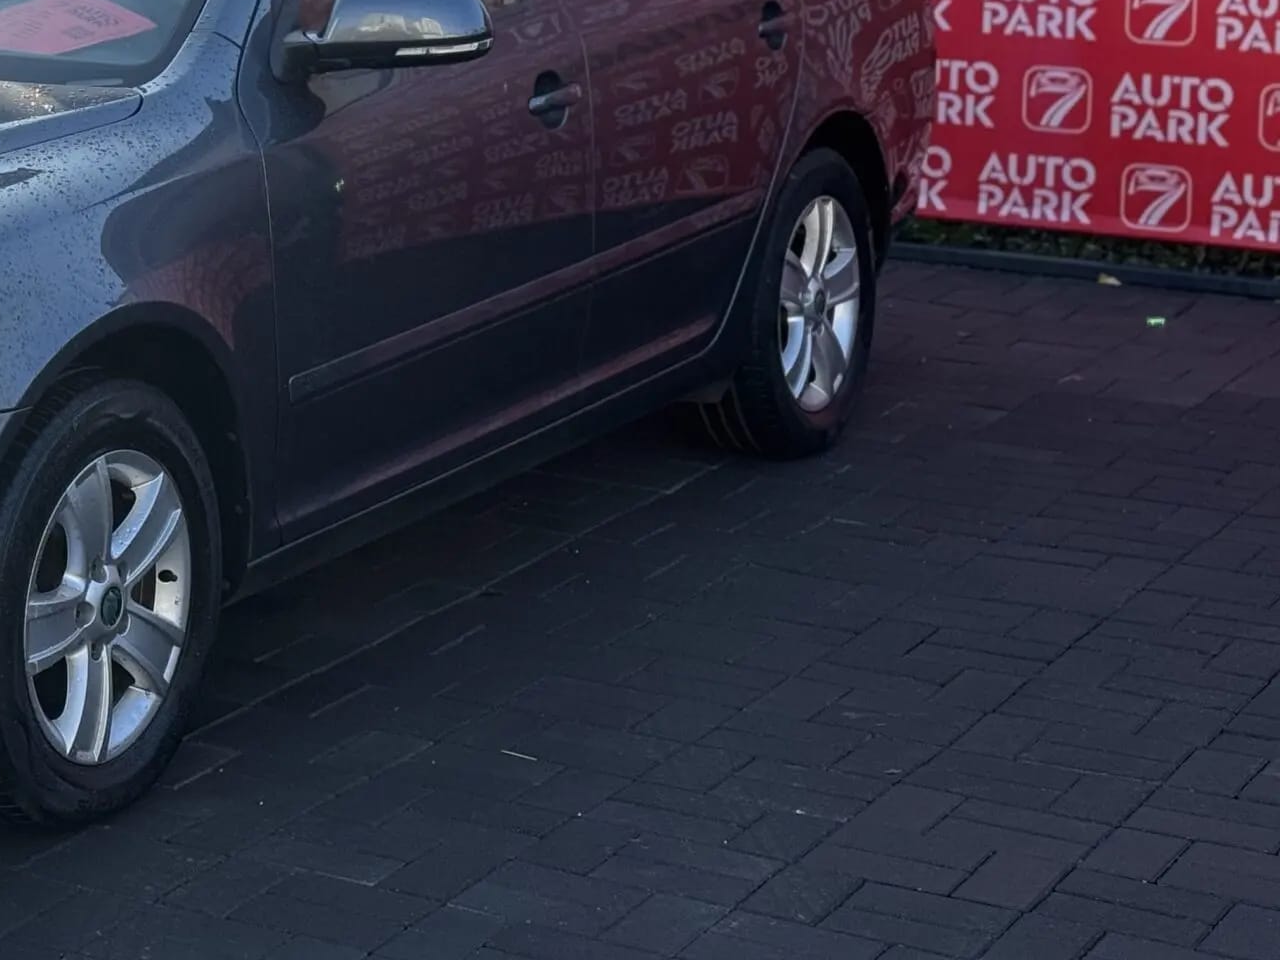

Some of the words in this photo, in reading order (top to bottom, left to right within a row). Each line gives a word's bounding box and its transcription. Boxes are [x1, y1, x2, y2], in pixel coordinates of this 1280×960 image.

[983, 2, 1096, 40] PARK
[1111, 73, 1233, 111] AUTO
[1111, 105, 1229, 146] PARK
[979, 153, 1096, 190] AUTO
[978, 186, 1091, 224] PARK
